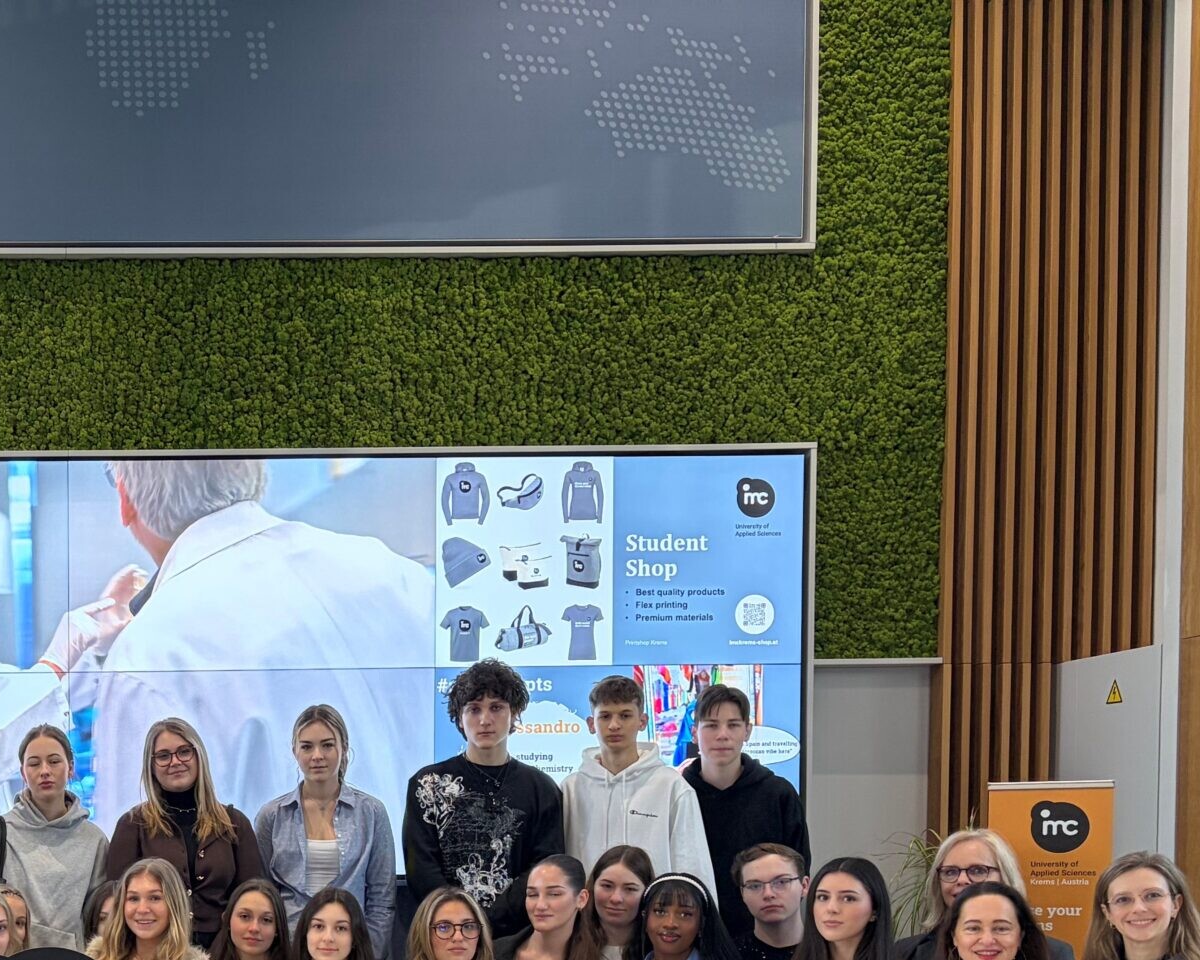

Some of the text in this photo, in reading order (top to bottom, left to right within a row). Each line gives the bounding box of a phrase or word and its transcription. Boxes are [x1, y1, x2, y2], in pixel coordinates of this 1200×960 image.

[742, 483, 769, 505] imc
[735, 523, 761, 531] University
[626, 534, 709, 551] Student
[626, 559, 678, 581] Shop
[635, 588, 725, 597] Best quality products
[635, 601, 688, 610] Flex printing
[635, 613, 714, 622] Premium materials
[516, 719, 581, 734] ssandro
[1040, 809, 1079, 836] imc
[1030, 869, 1097, 877] Applied Sciences
[1030, 878, 1055, 886] Krems
[1061, 878, 1089, 886] Austria
[1047, 906, 1083, 919] your
